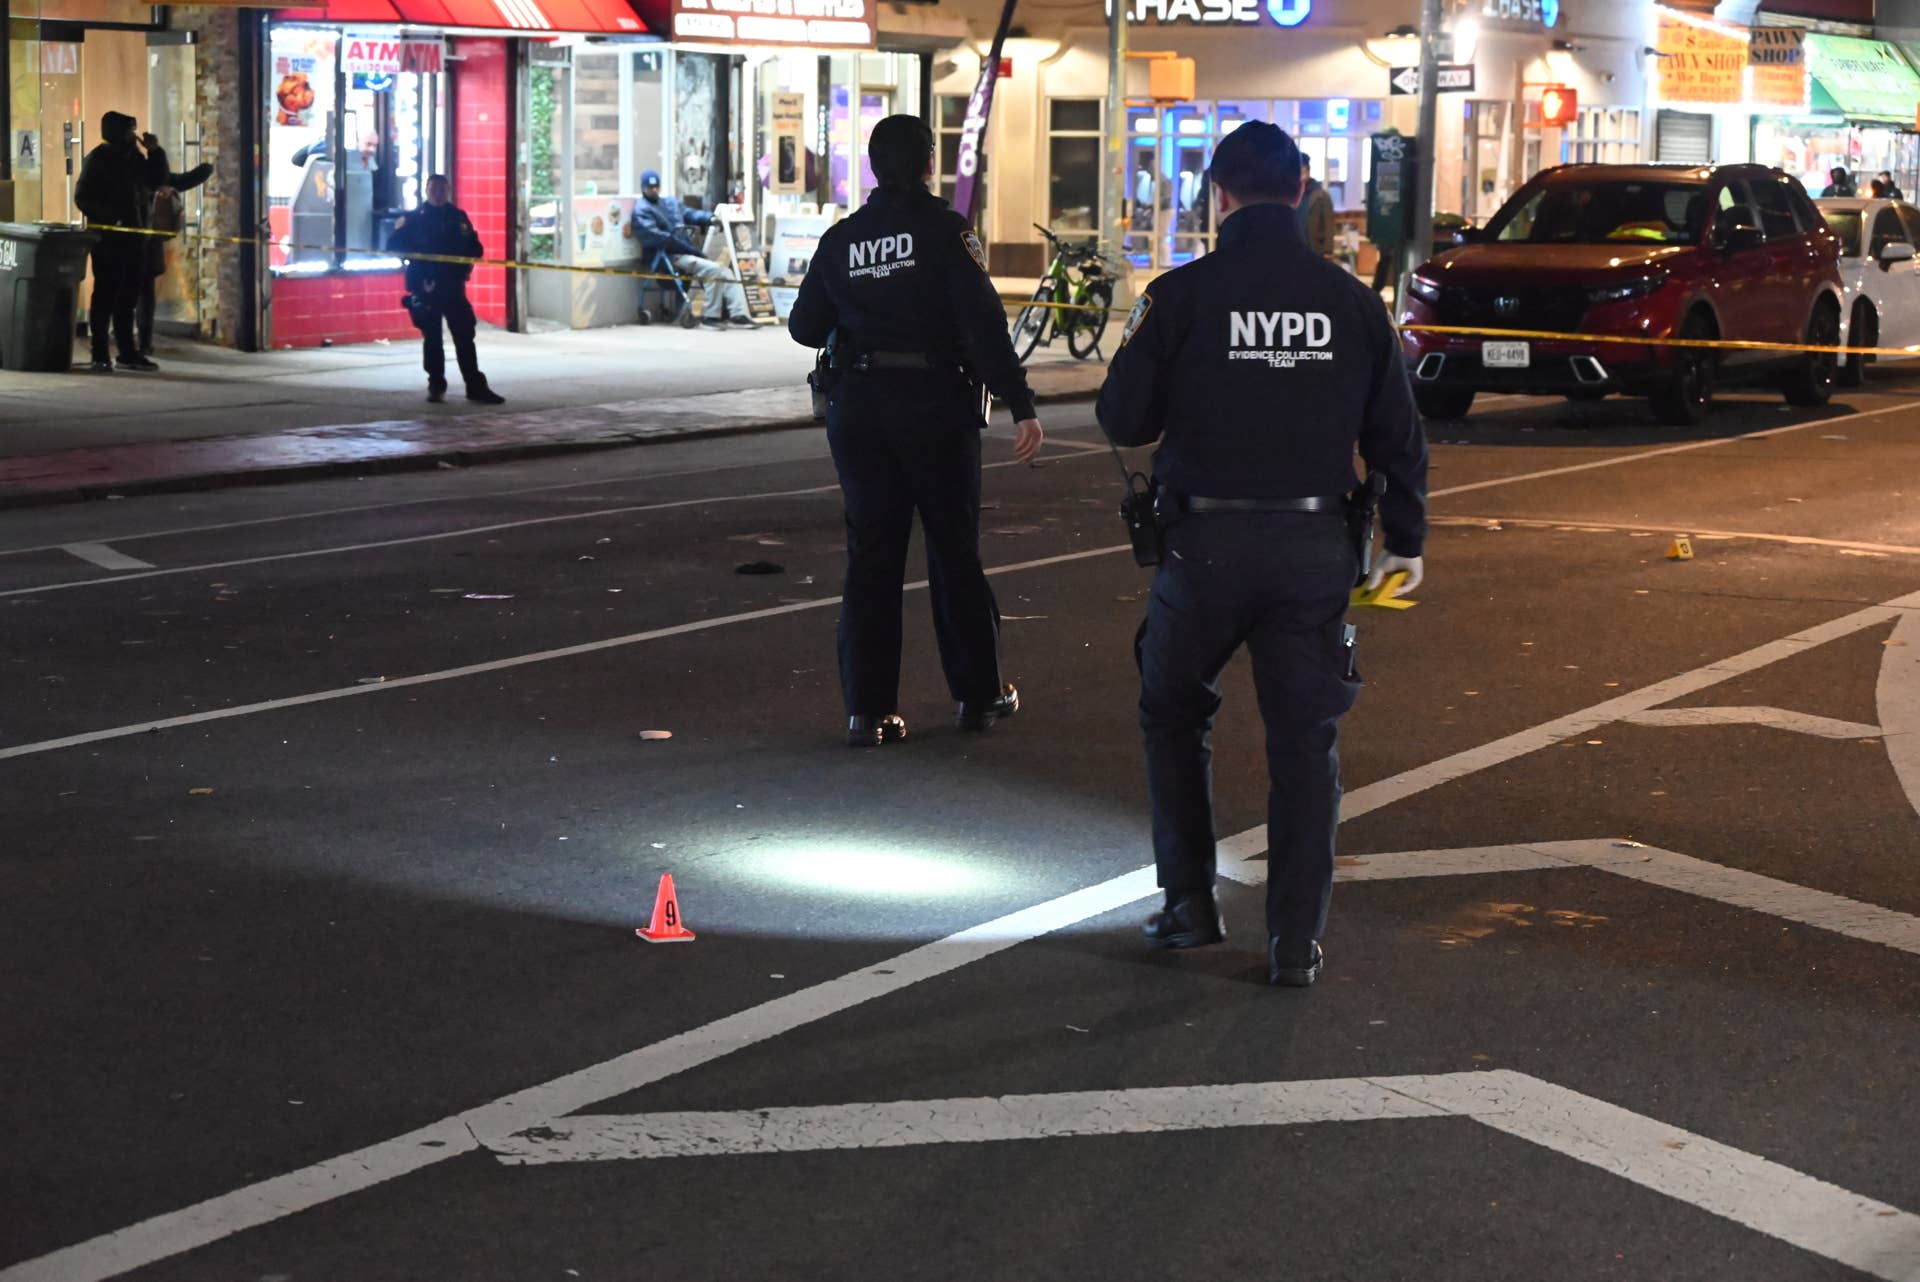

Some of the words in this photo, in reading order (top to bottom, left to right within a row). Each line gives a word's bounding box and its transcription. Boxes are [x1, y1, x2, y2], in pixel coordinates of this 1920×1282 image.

[1751, 30, 1803, 45] PAWN
[346, 41, 400, 61] ATM
[400, 42, 441, 72] ATM
[1751, 48, 1801, 64] SHOP
[1706, 53, 1745, 70] SHOP
[1437, 73, 1464, 85] WAY
[20, 134, 33, 157] A
[849, 233, 913, 268] NYPD
[849, 265, 877, 278] EVIDENCE
[876, 259, 915, 272] COLLECTION
[872, 270, 890, 279] TEAM
[1230, 311, 1331, 347] NYPD
[1228, 350, 1275, 360] EVIDENCE
[1275, 350, 1333, 361] COLLECTION
[1268, 359, 1296, 368] TEAM
[666, 900, 676, 926] 9
